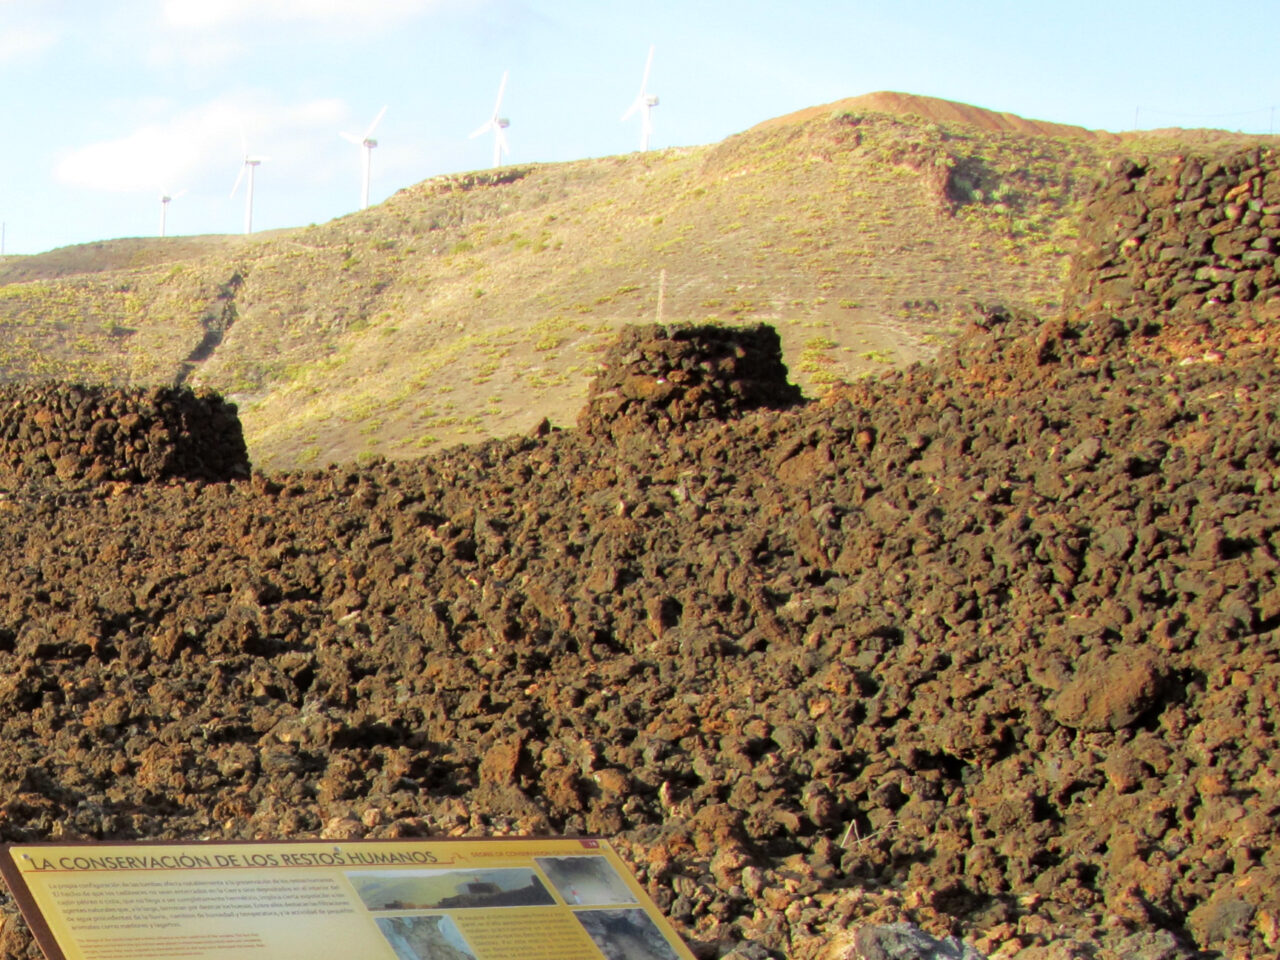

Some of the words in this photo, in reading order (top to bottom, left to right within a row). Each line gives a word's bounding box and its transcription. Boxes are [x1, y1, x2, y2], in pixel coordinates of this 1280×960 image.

[30, 857, 57, 870] LA
[60, 853, 211, 870] CONSERVACIÓN
[214, 855, 241, 867] DE
[242, 854, 279, 866] LOS
[281, 852, 346, 865] RESTOS
[347, 850, 439, 864] HUMANOS
